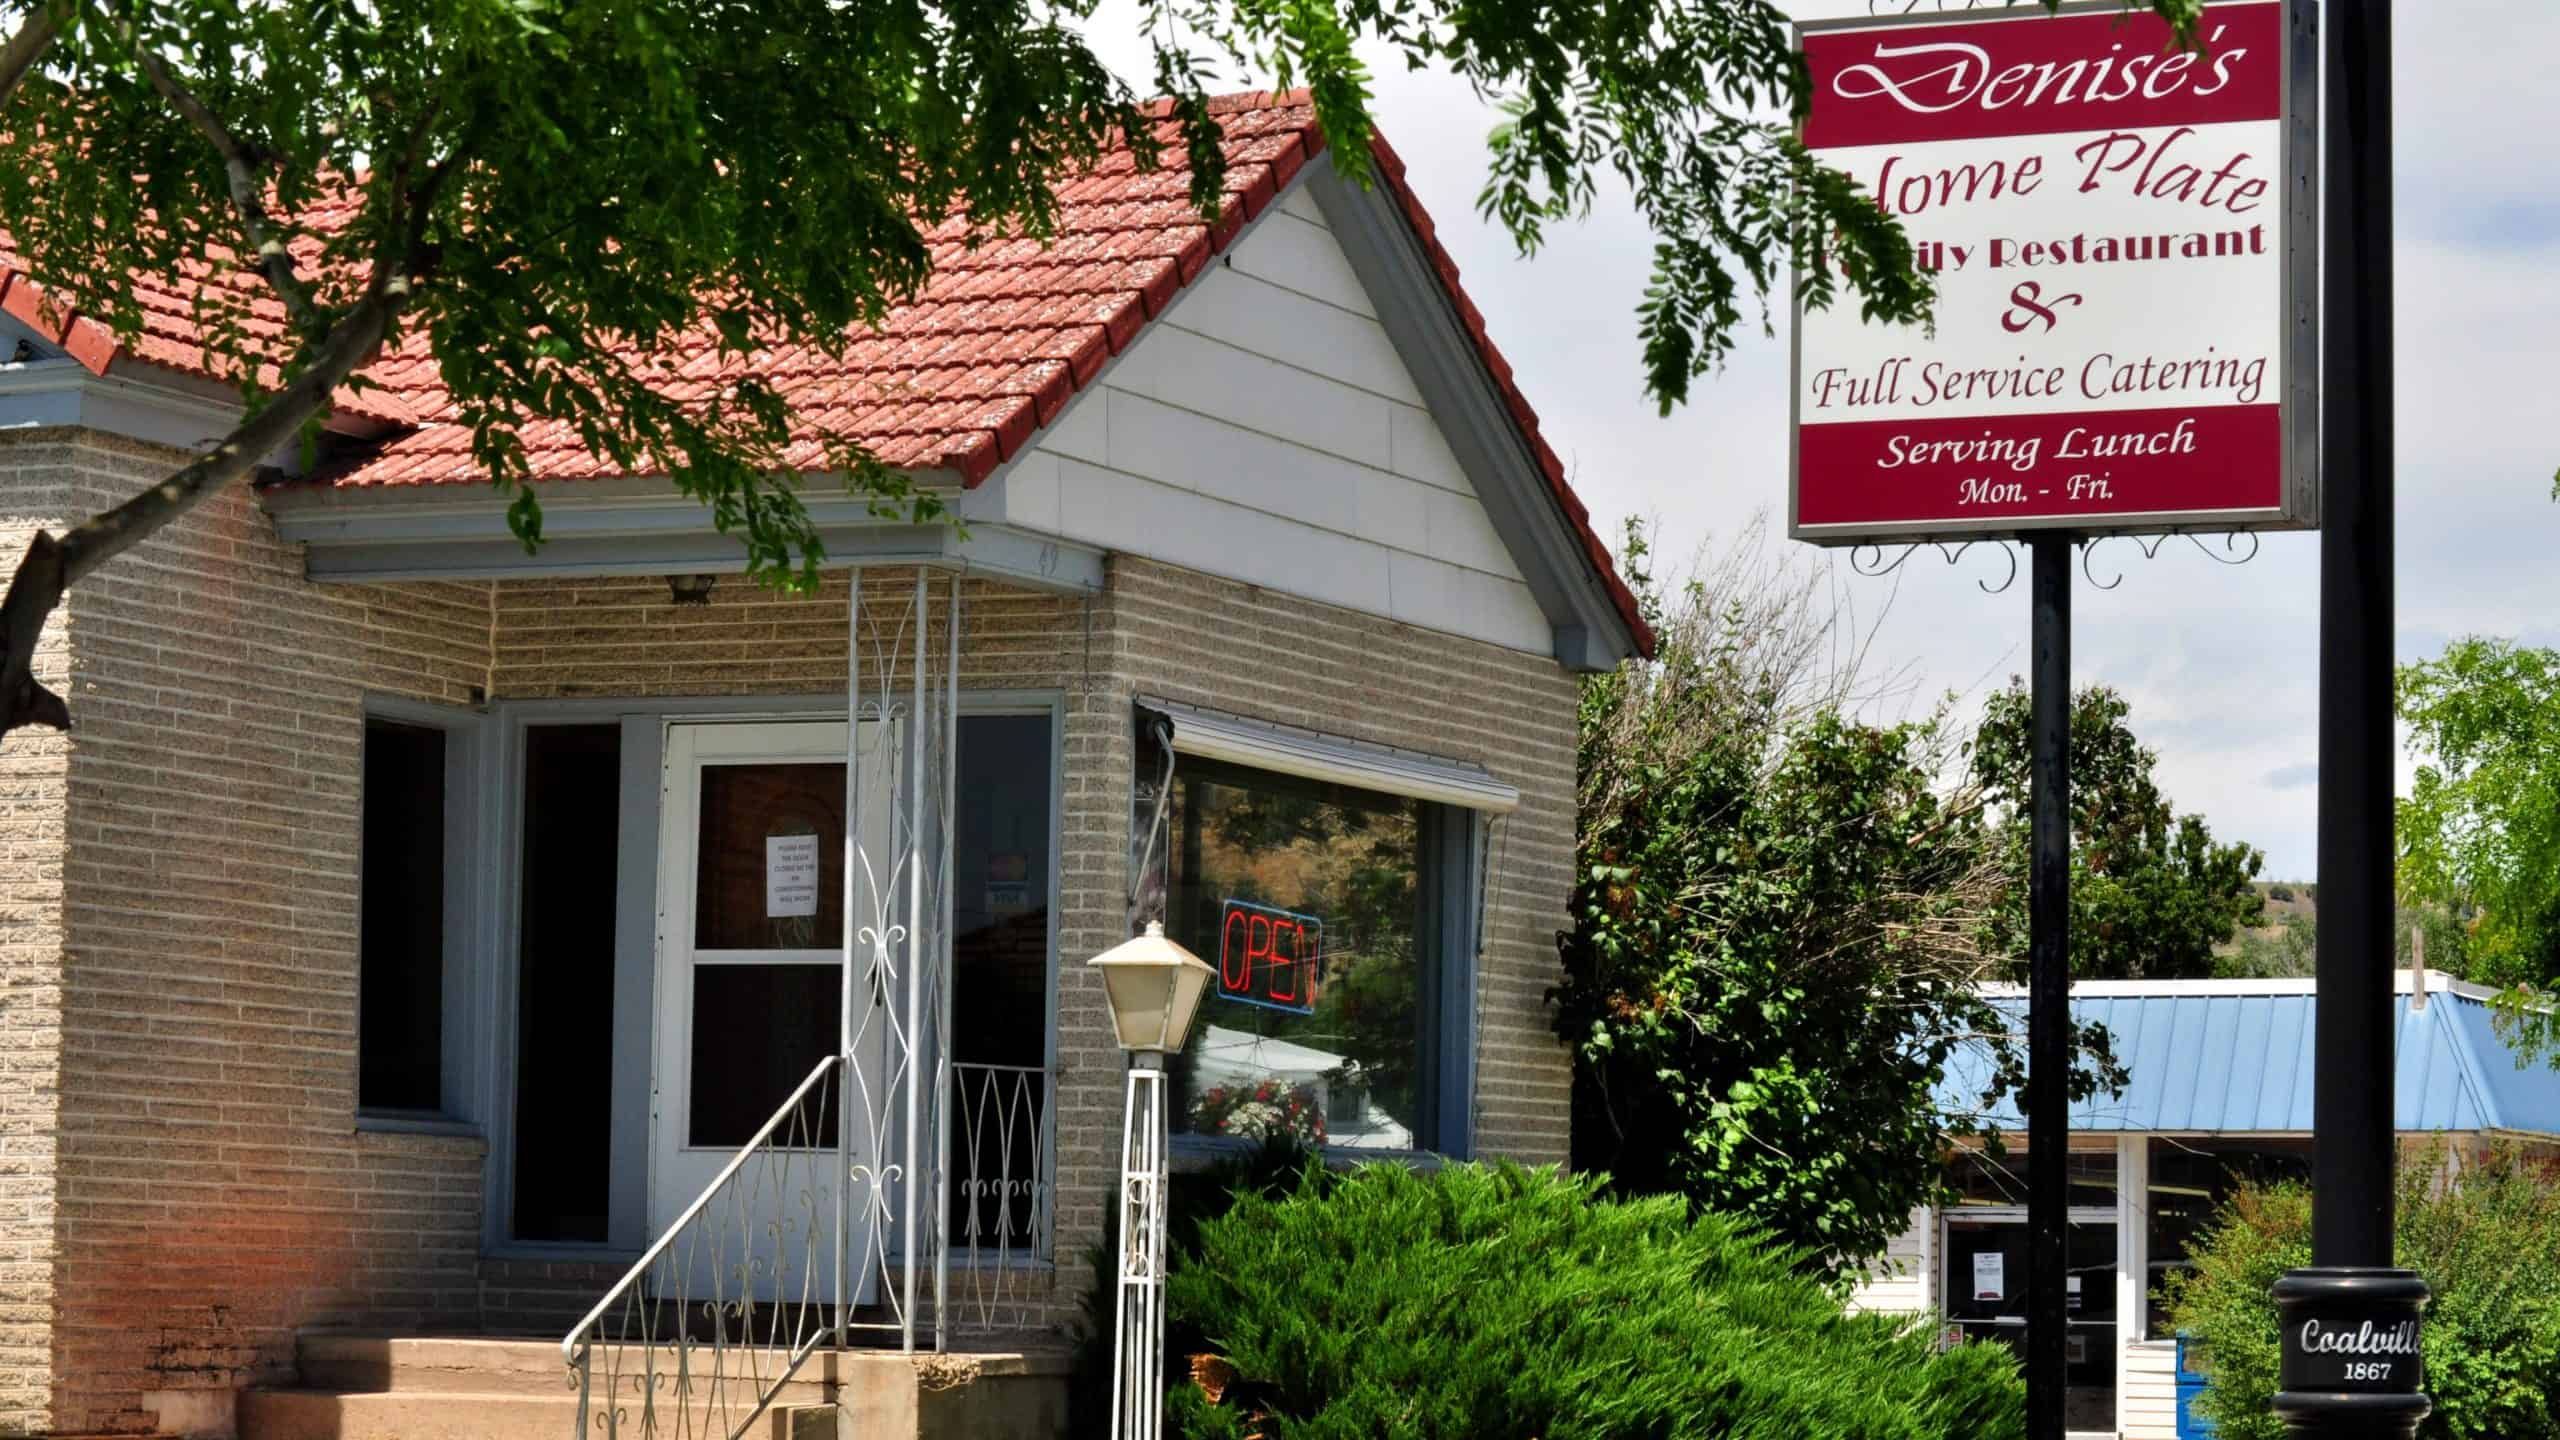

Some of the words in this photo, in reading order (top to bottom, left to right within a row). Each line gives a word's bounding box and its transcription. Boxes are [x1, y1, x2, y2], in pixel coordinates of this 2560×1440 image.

[1833, 25, 2247, 113] Denise's
[2075, 127, 2268, 213] Plate
[1989, 223, 2267, 268] Restaurant
[2001, 281, 2083, 333] &
[1812, 357, 1912, 408] Full
[1911, 355, 2065, 407] Service
[2080, 346, 2267, 403] Catering
[1877, 430, 2041, 471] Serving
[2054, 418, 2196, 459] Lunch
[1958, 477, 2028, 505] Mon.
[2066, 472, 2114, 500] Fri.
[1223, 911, 1317, 1005] OPEN
[2344, 1363, 2392, 1381] 1867
